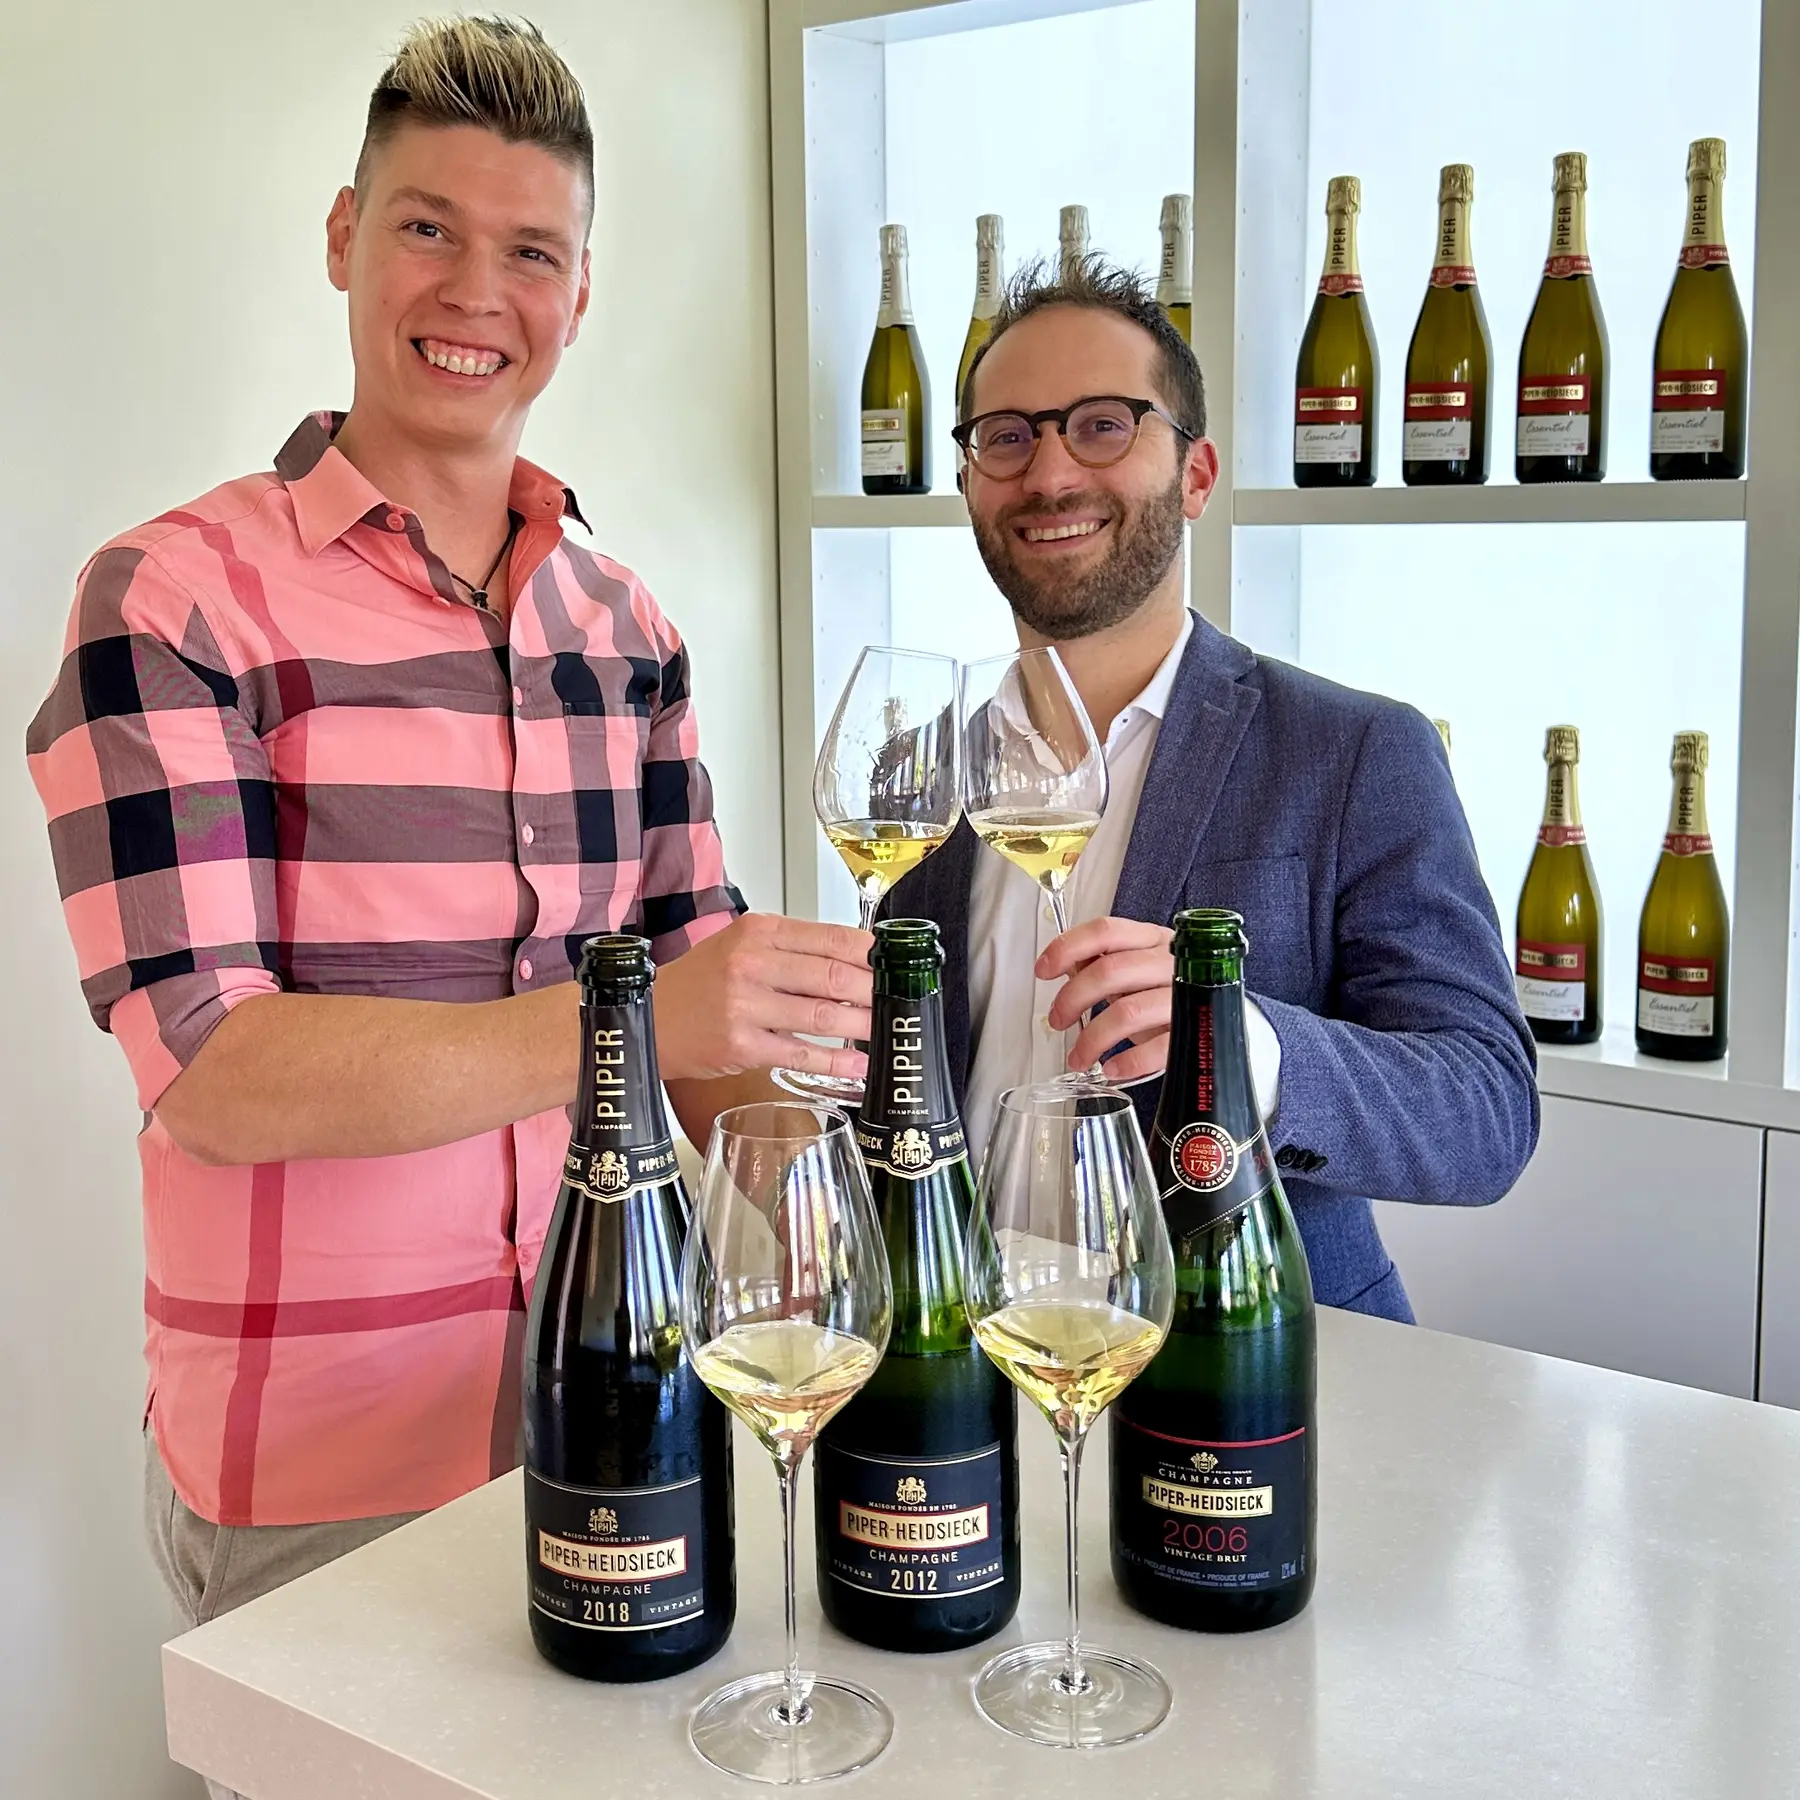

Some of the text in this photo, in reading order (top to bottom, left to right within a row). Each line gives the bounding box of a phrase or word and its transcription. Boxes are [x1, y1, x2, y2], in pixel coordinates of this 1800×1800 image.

[1556, 206, 1572, 246] PIPER
[1692, 194, 1707, 236] PIPER
[1331, 227, 1346, 265] PIPER
[1442, 218, 1456, 257] PIPER
[1163, 242, 1175, 278] PIPER
[882, 268, 892, 301] PIPER
[979, 260, 990, 294] PIPER
[1550, 778, 1564, 817] PIPER
[1678, 786, 1694, 826] PIPER
[595, 1029, 627, 1119] PIPER
[892, 1016, 924, 1104] PIPER
[1190, 1159, 1217, 1174] 1785
[1158, 1468, 1253, 1485] CHAMPAGNE
[1148, 1482, 1264, 1511] PIPER-HEIDSIECK
[847, 1511, 981, 1542] PIPER-HEIDSIECK
[1163, 1519, 1248, 1552] 2006
[544, 1540, 678, 1572] PIPER-HEIDSIECK
[869, 1549, 959, 1564] CHAMPAGNE
[1163, 1546, 1248, 1563] VINTAGE BRUT
[563, 1579, 652, 1596] CHAMPAGNE
[891, 1569, 938, 1591] 2012
[956, 1562, 1000, 1582] VINTAGE
[583, 1600, 630, 1623] 2018
[649, 1595, 698, 1613] VINTAGE
